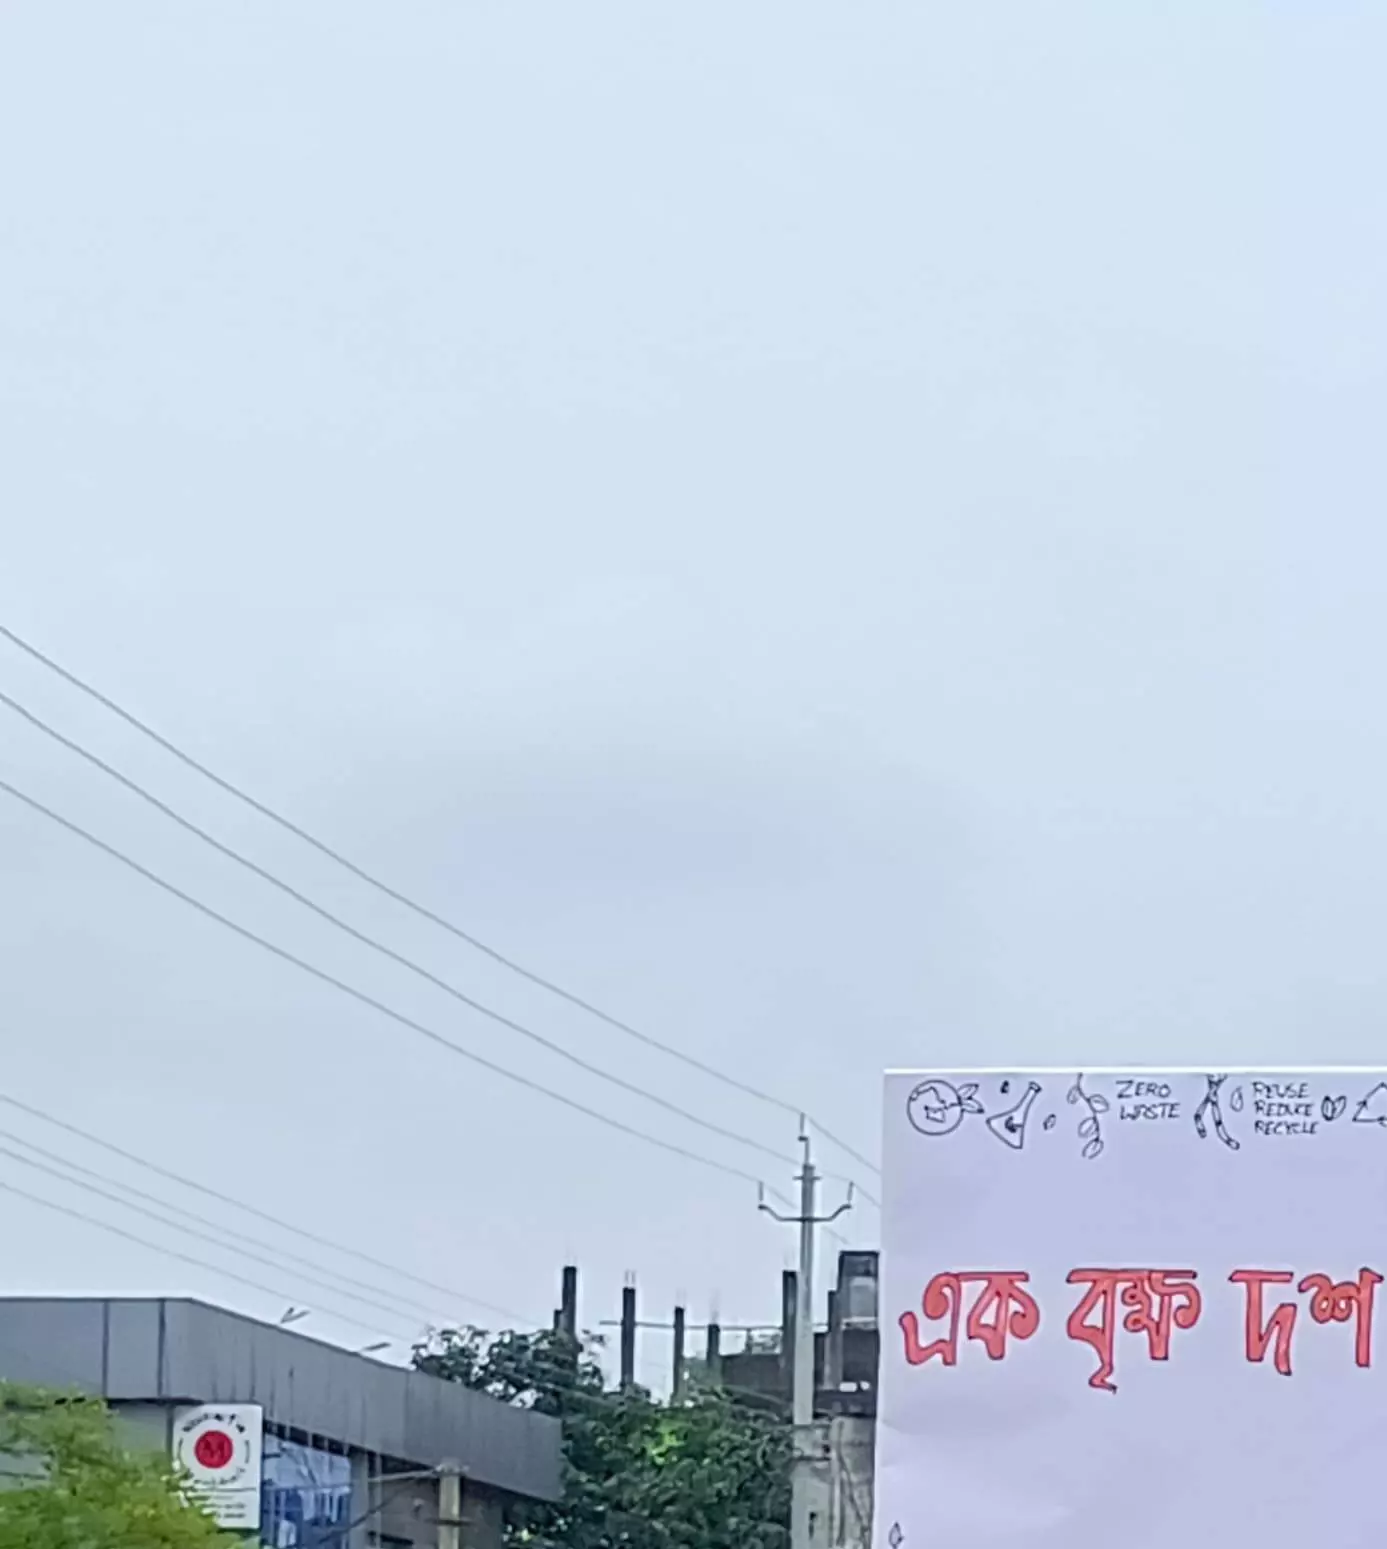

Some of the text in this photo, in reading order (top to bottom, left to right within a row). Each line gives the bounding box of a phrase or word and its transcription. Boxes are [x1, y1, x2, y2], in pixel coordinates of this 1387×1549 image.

[1115, 1079, 1172, 1098] ZERO
[1252, 1081, 1309, 1098] REUSE
[1120, 1102, 1182, 1120] WASTE
[1254, 1100, 1314, 1117] REDUCE
[1254, 1120, 1319, 1135] RECYCLE
[899, 1271, 1040, 1366] এক
[1066, 1269, 1201, 1394] বৃক্ষ
[1228, 1267, 1384, 1376] দশ
